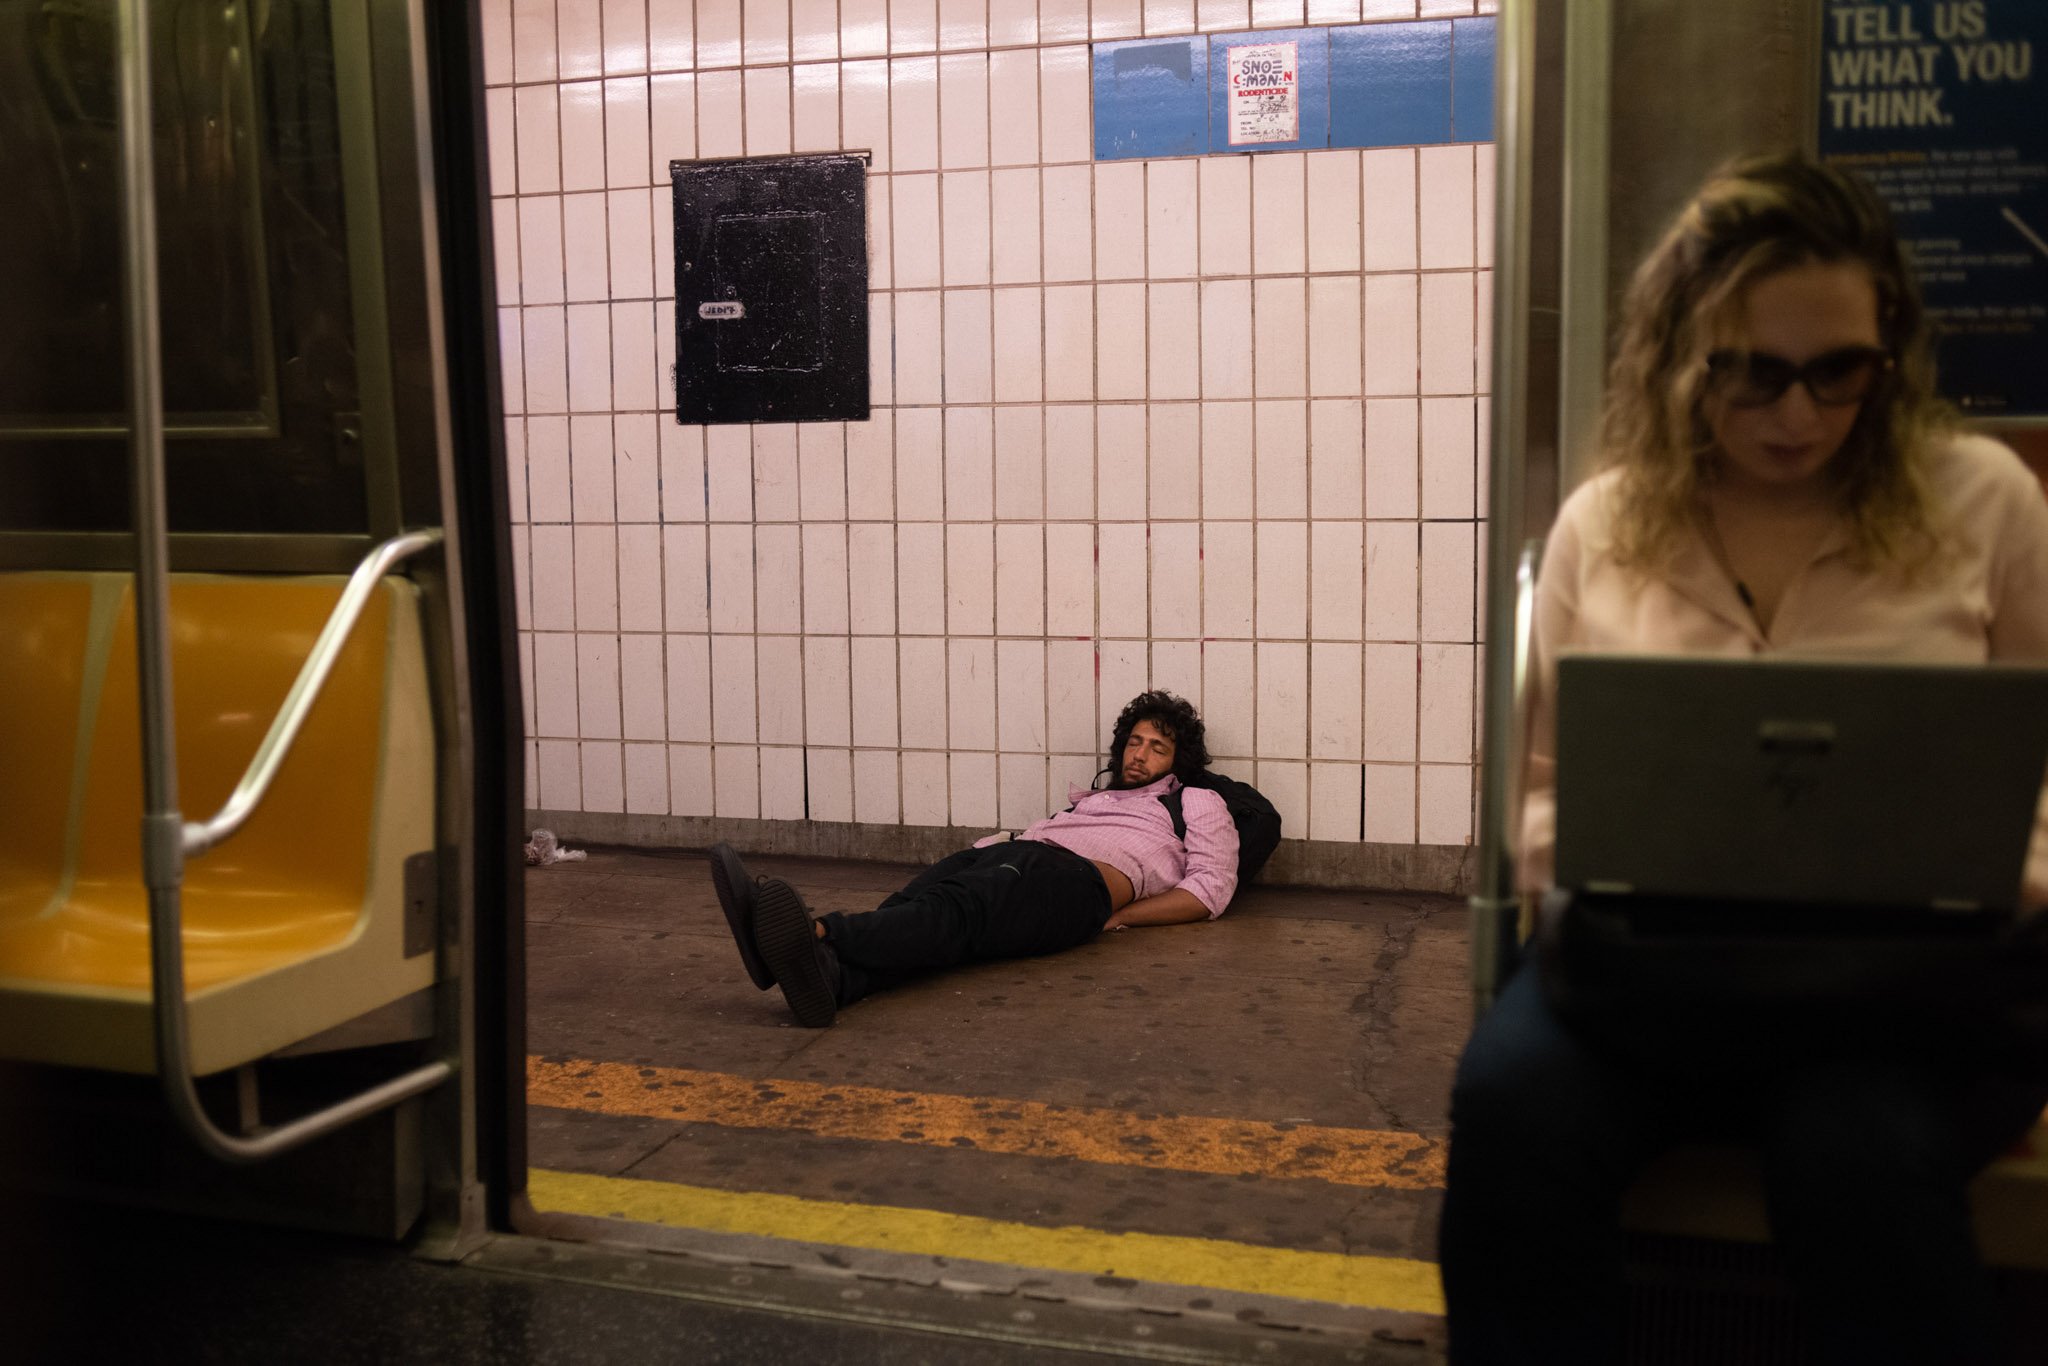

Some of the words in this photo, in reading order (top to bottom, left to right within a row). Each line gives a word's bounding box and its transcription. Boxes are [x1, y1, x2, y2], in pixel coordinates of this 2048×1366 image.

[1831, 5, 1922, 44] TELL
[1933, 0, 1986, 40] US
[1829, 44, 1941, 86] WHAT
[1952, 41, 2032, 82] YOU
[1827, 87, 1954, 129] THINK.
